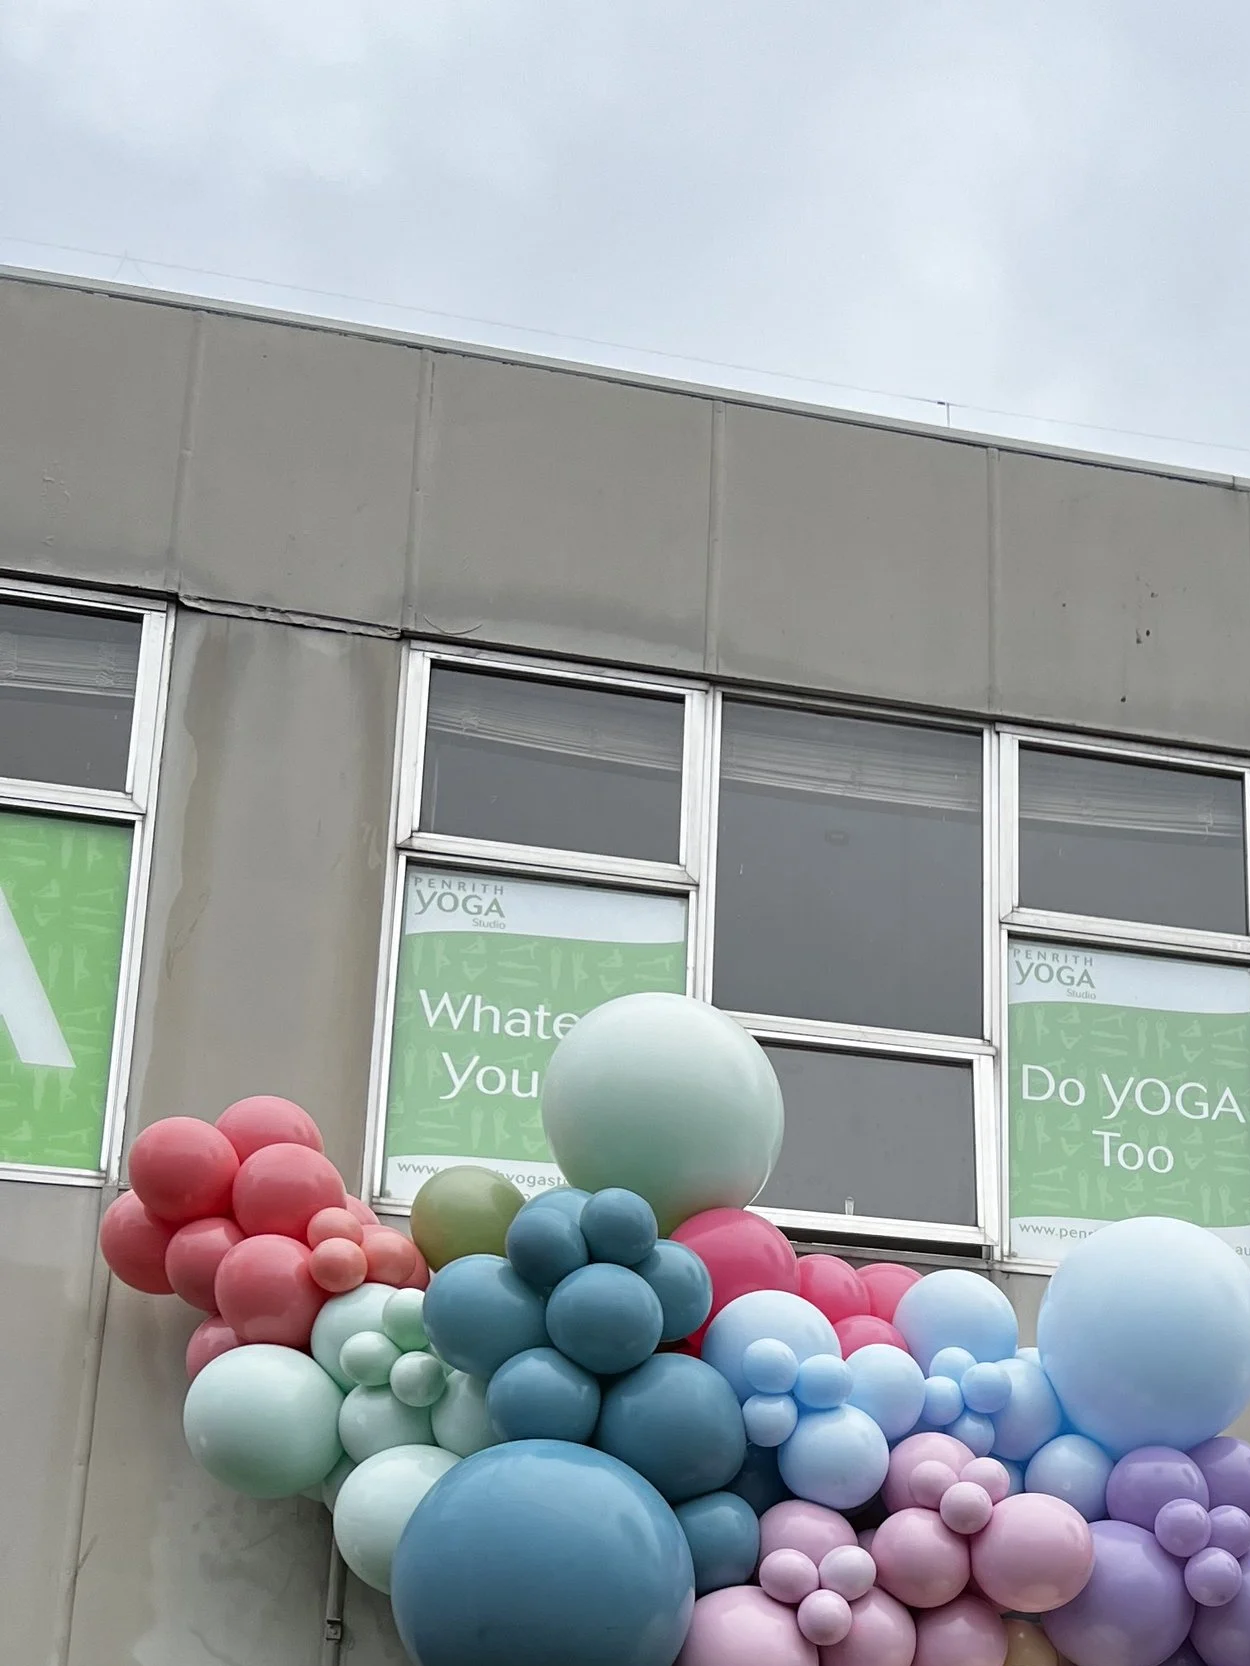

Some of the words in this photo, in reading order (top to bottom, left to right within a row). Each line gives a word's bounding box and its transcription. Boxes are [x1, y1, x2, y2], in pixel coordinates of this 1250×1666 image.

[414, 876, 504, 896] PENRITH
[472, 917, 506, 930] Studio
[1013, 948, 1093, 967] PENRITH
[1066, 988, 1097, 1000] Studio
[419, 989, 580, 1040] Whate
[1021, 1064, 1086, 1107] Do
[1092, 1130, 1174, 1174] Too
